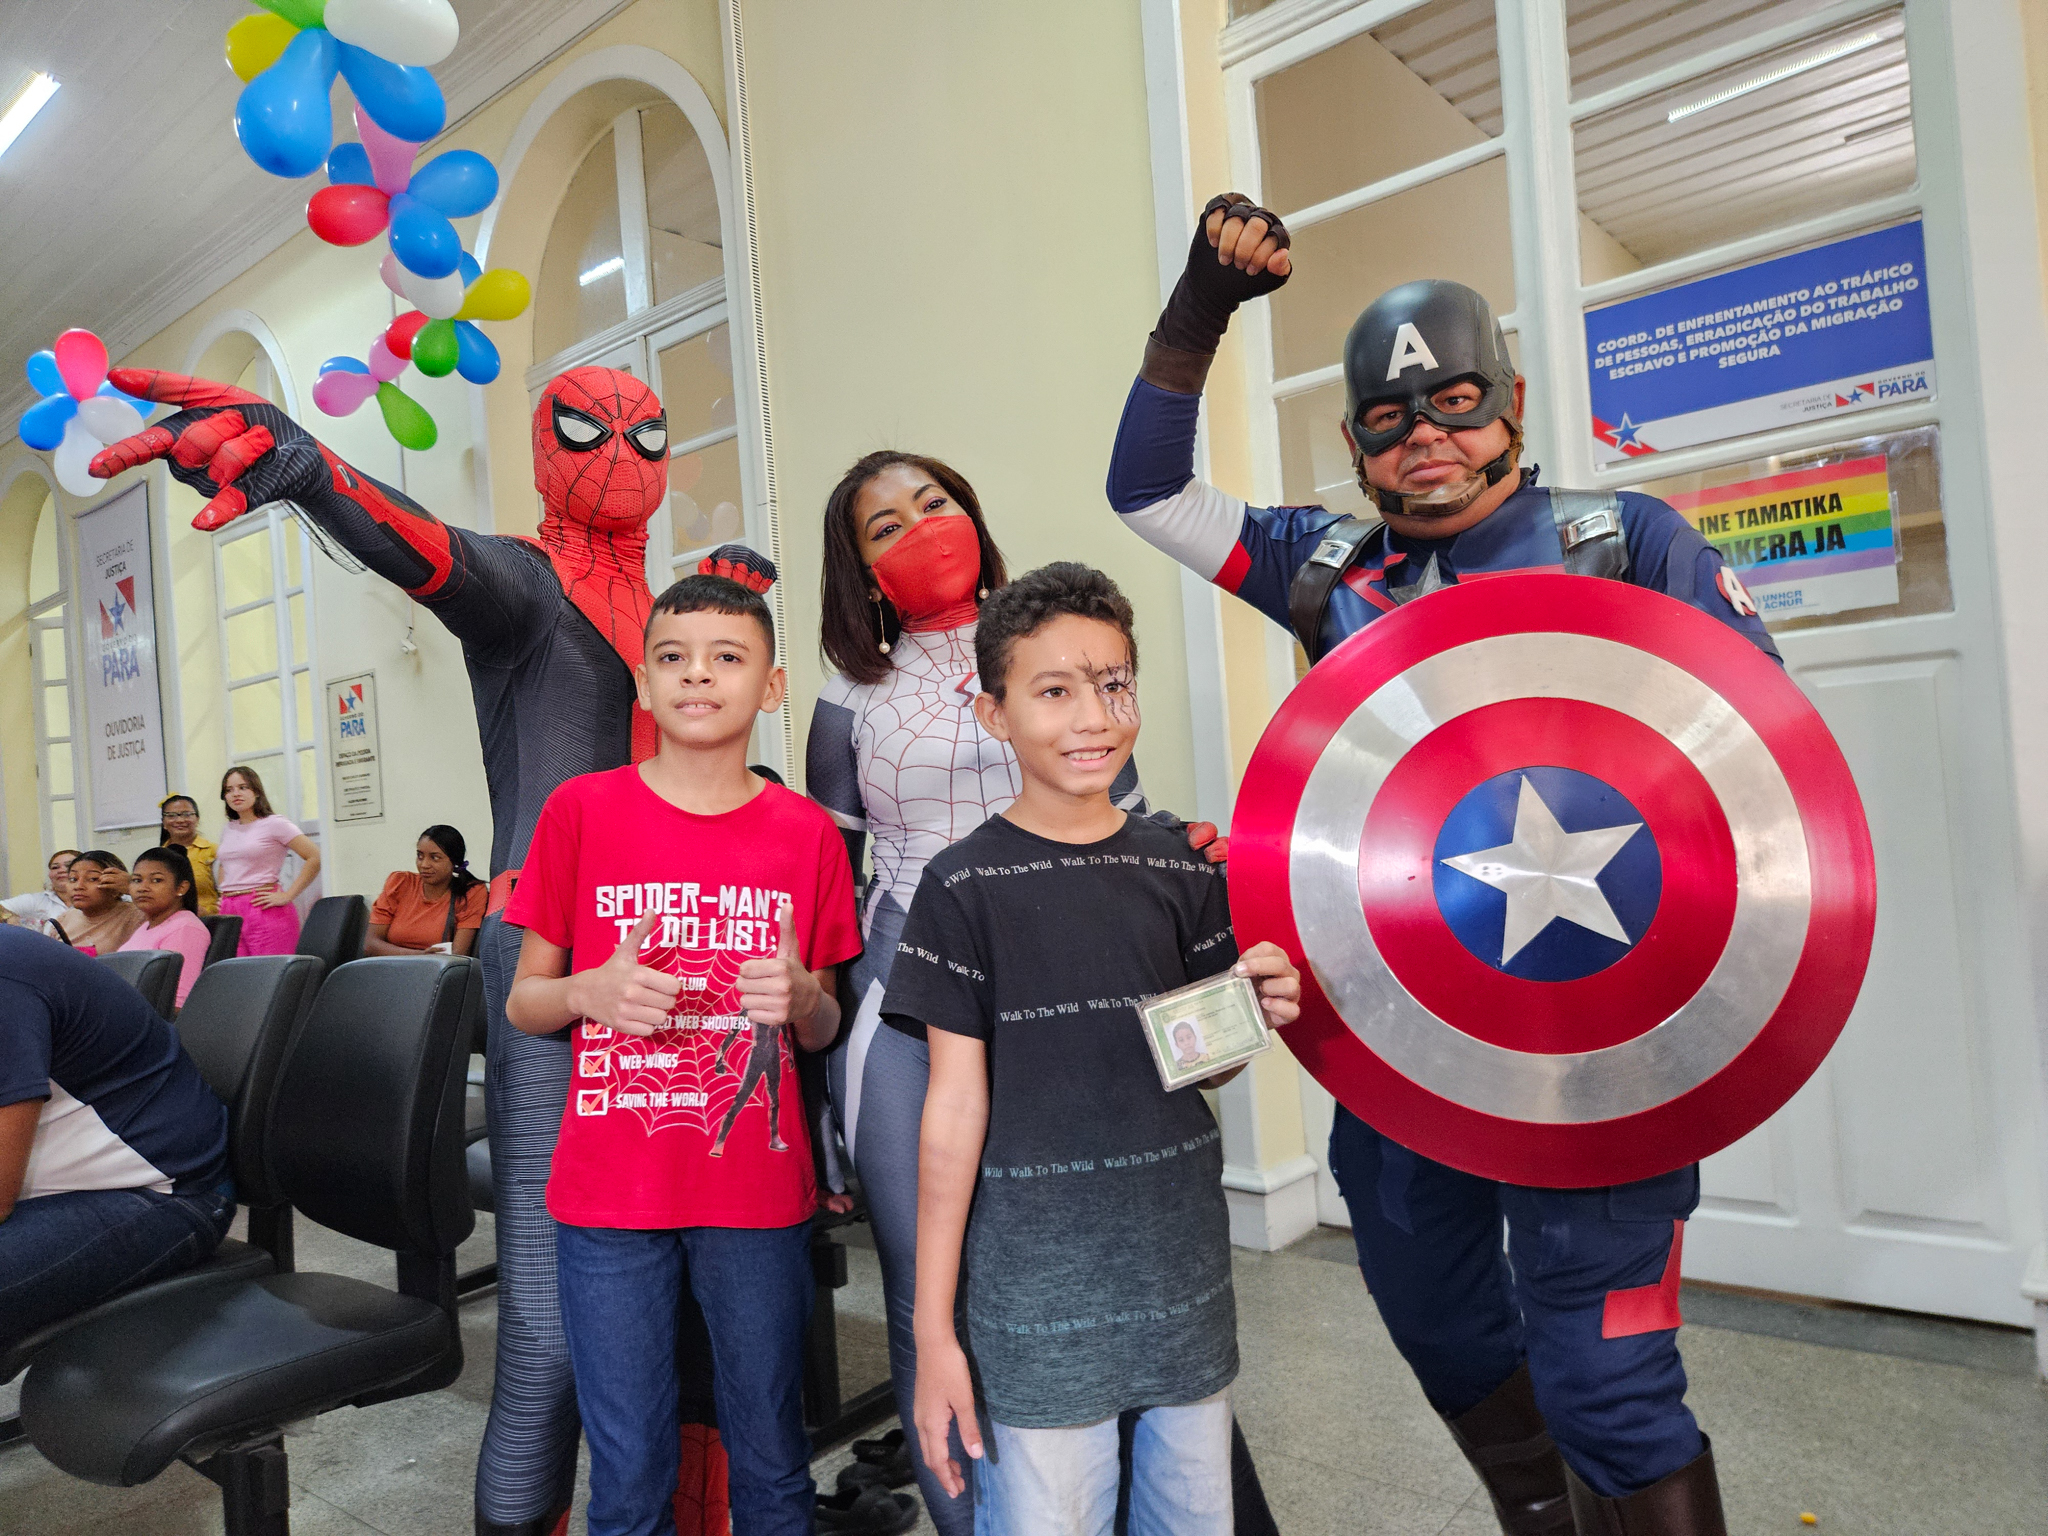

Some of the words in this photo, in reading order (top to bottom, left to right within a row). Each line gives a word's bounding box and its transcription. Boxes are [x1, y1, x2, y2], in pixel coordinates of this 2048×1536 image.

[1596, 332, 1653, 353] COORD.
[1655, 322, 1675, 338] DE
[1677, 289, 1810, 334] ENFRENTAMENTO
[1813, 281, 1838, 299] AO
[1840, 262, 1914, 289] TRÁFICO
[1595, 355, 1614, 369] DE
[1615, 338, 1684, 364] PESSOAS,
[1686, 308, 1797, 346] ERRADICAÇÃO
[1800, 300, 1825, 318] DO
[1828, 277, 1920, 310] TRABALHO
[1385, 322, 1439, 381] A
[1609, 355, 1675, 380] ESCRAVO
[1677, 352, 1687, 364] E
[1689, 327, 1782, 361] PROMOÇÃO
[1784, 321, 1809, 337] DA
[1811, 297, 1904, 330] MIGRAÇÃO
[1718, 345, 1781, 369] SEGURA
[1802, 402, 1833, 413] JUSTIÇA
[1734, 492, 1843, 529] TAMATIKA
[97, 545, 126, 567] SECRETARIA
[126, 539, 135, 552] DE
[1714, 530, 1807, 568] AKERA
[1814, 523, 1846, 553] JA
[105, 561, 126, 579] JUSTIÇA
[1762, 590, 1803, 601] UNHCR
[1764, 598, 1803, 609] ACNUR
[105, 714, 146, 737] OUVIDORIA
[107, 745, 117, 761] DE
[117, 739, 146, 760] JUSTIÇA
[949, 868, 971, 884] Wild
[975, 866, 998, 877] Walk
[999, 867, 1010, 875] To
[1011, 865, 1029, 874] The
[1029, 860, 1053, 871] Wild
[1060, 857, 1085, 868] Walk
[1088, 856, 1101, 865] To
[1103, 855, 1119, 864] The
[1120, 855, 1140, 865] Wild
[1147, 857, 1167, 868] Walk
[1169, 859, 1179, 869] To
[1181, 861, 1196, 872] The
[660, 916, 700, 948] DO
[709, 918, 777, 951] LIST:
[1193, 938, 1216, 952] Walk
[1215, 931, 1227, 942] To
[897, 942, 914, 954] The
[917, 947, 939, 964] Wild
[947, 960, 969, 976] Walk
[972, 969, 985, 982] To
[675, 1015, 699, 1029] WEB
[701, 1015, 750, 1030] SHOOTERS
[1000, 1011, 1023, 1022] Walk
[1023, 1009, 1036, 1019] To
[1037, 1006, 1055, 1017] The
[1056, 1002, 1079, 1014] Wild
[1087, 998, 1110, 1010] Walk
[1110, 999, 1121, 1008] To
[1122, 997, 1138, 1007] The
[619, 1053, 678, 1070] WEB-WINGS
[616, 1093, 647, 1108] SAVING
[648, 1092, 669, 1107] THE
[670, 1092, 708, 1107] WORLD
[984, 1167, 1003, 1178] Wild
[1009, 1166, 1034, 1178] Walk
[1035, 1165, 1048, 1175] To
[1050, 1163, 1068, 1173] The
[1070, 1160, 1094, 1171] Wild
[1104, 1156, 1128, 1168] Walk
[1129, 1154, 1142, 1165] To
[1144, 1151, 1160, 1162] The
[1161, 1146, 1178, 1158] Wild
[1006, 1323, 1031, 1334] Walk
[1034, 1323, 1048, 1333] To
[1049, 1321, 1070, 1332] The
[1072, 1318, 1096, 1329] Wild
[1105, 1310, 1130, 1323] Walk
[1133, 1311, 1146, 1320] To
[1149, 1310, 1167, 1320] The
[1169, 1301, 1189, 1315] Wild
